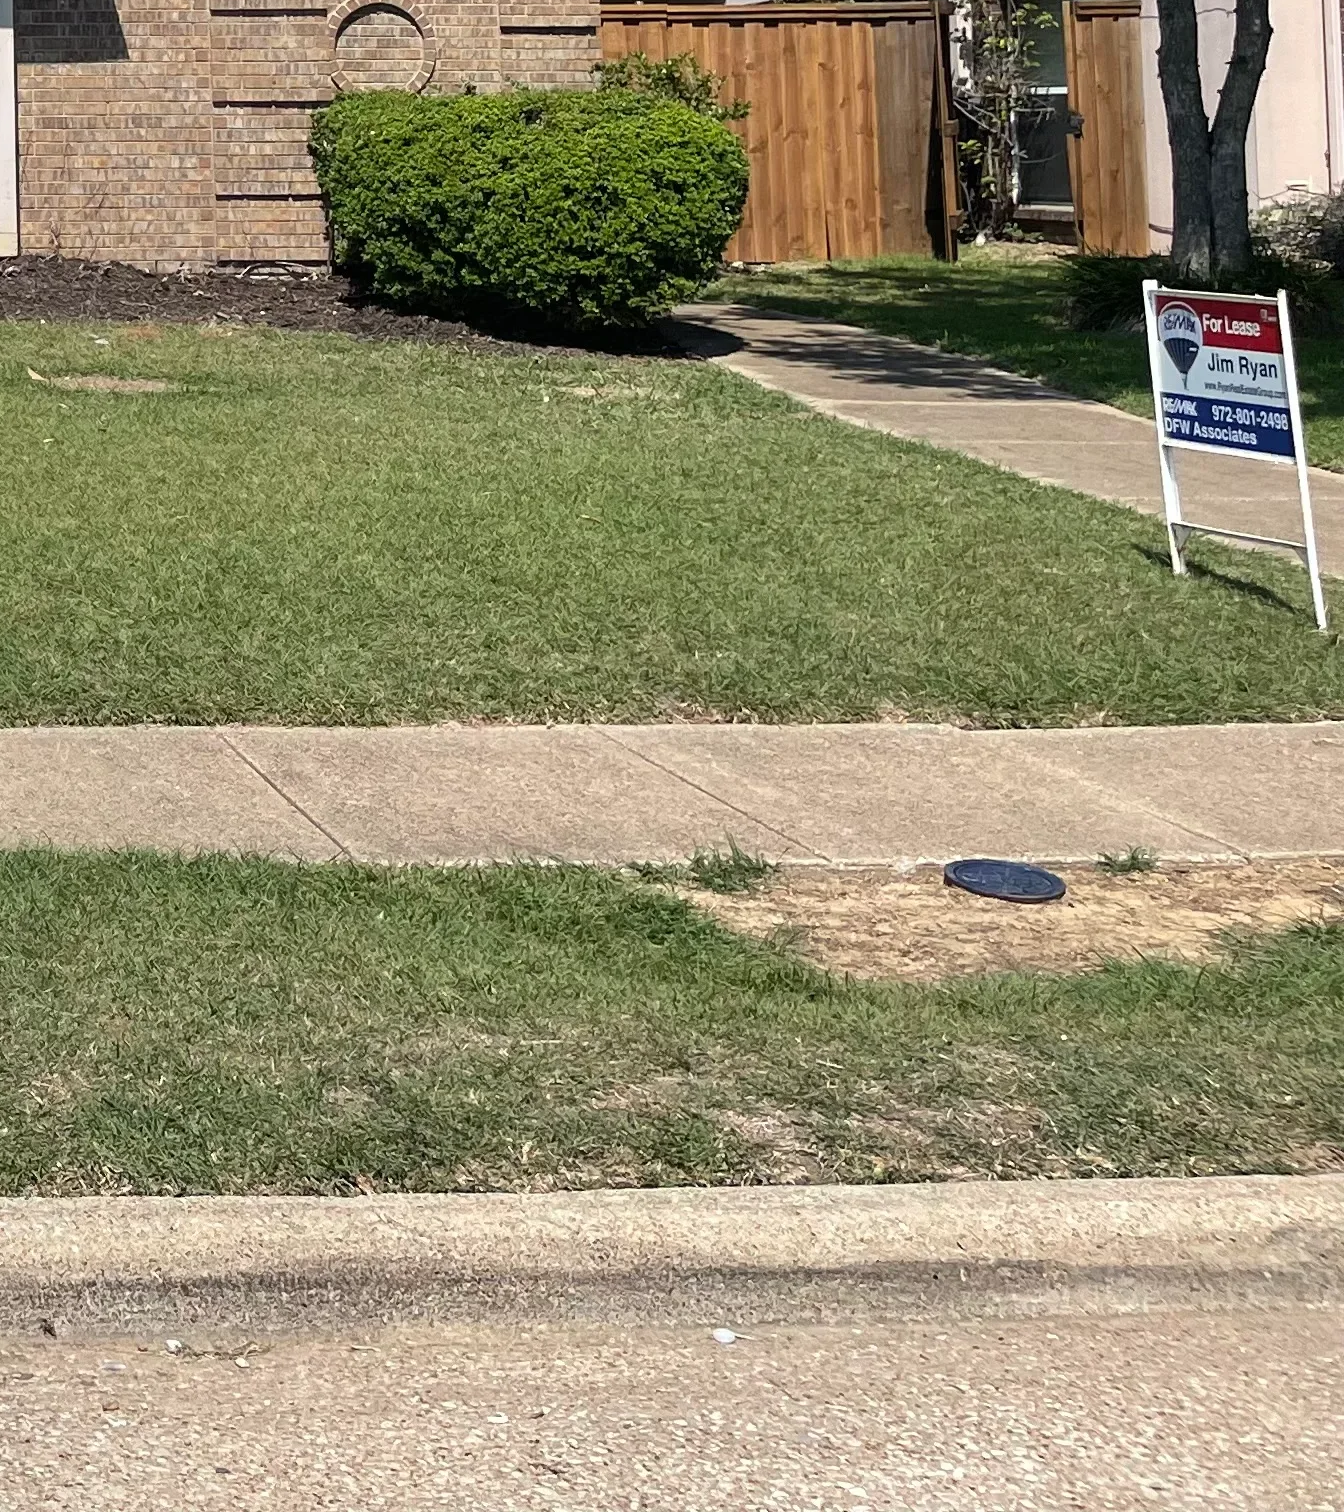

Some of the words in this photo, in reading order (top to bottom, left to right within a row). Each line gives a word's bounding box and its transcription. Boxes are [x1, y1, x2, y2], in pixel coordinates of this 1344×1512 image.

[1202, 313, 1223, 333] For
[1224, 315, 1261, 337] Lease
[1208, 353, 1234, 374] Jim
[1238, 356, 1278, 381] Ryan
[1164, 416, 1191, 435] DFW
[1193, 421, 1257, 445] Associates
[1211, 404, 1289, 430] 972-801-2498
